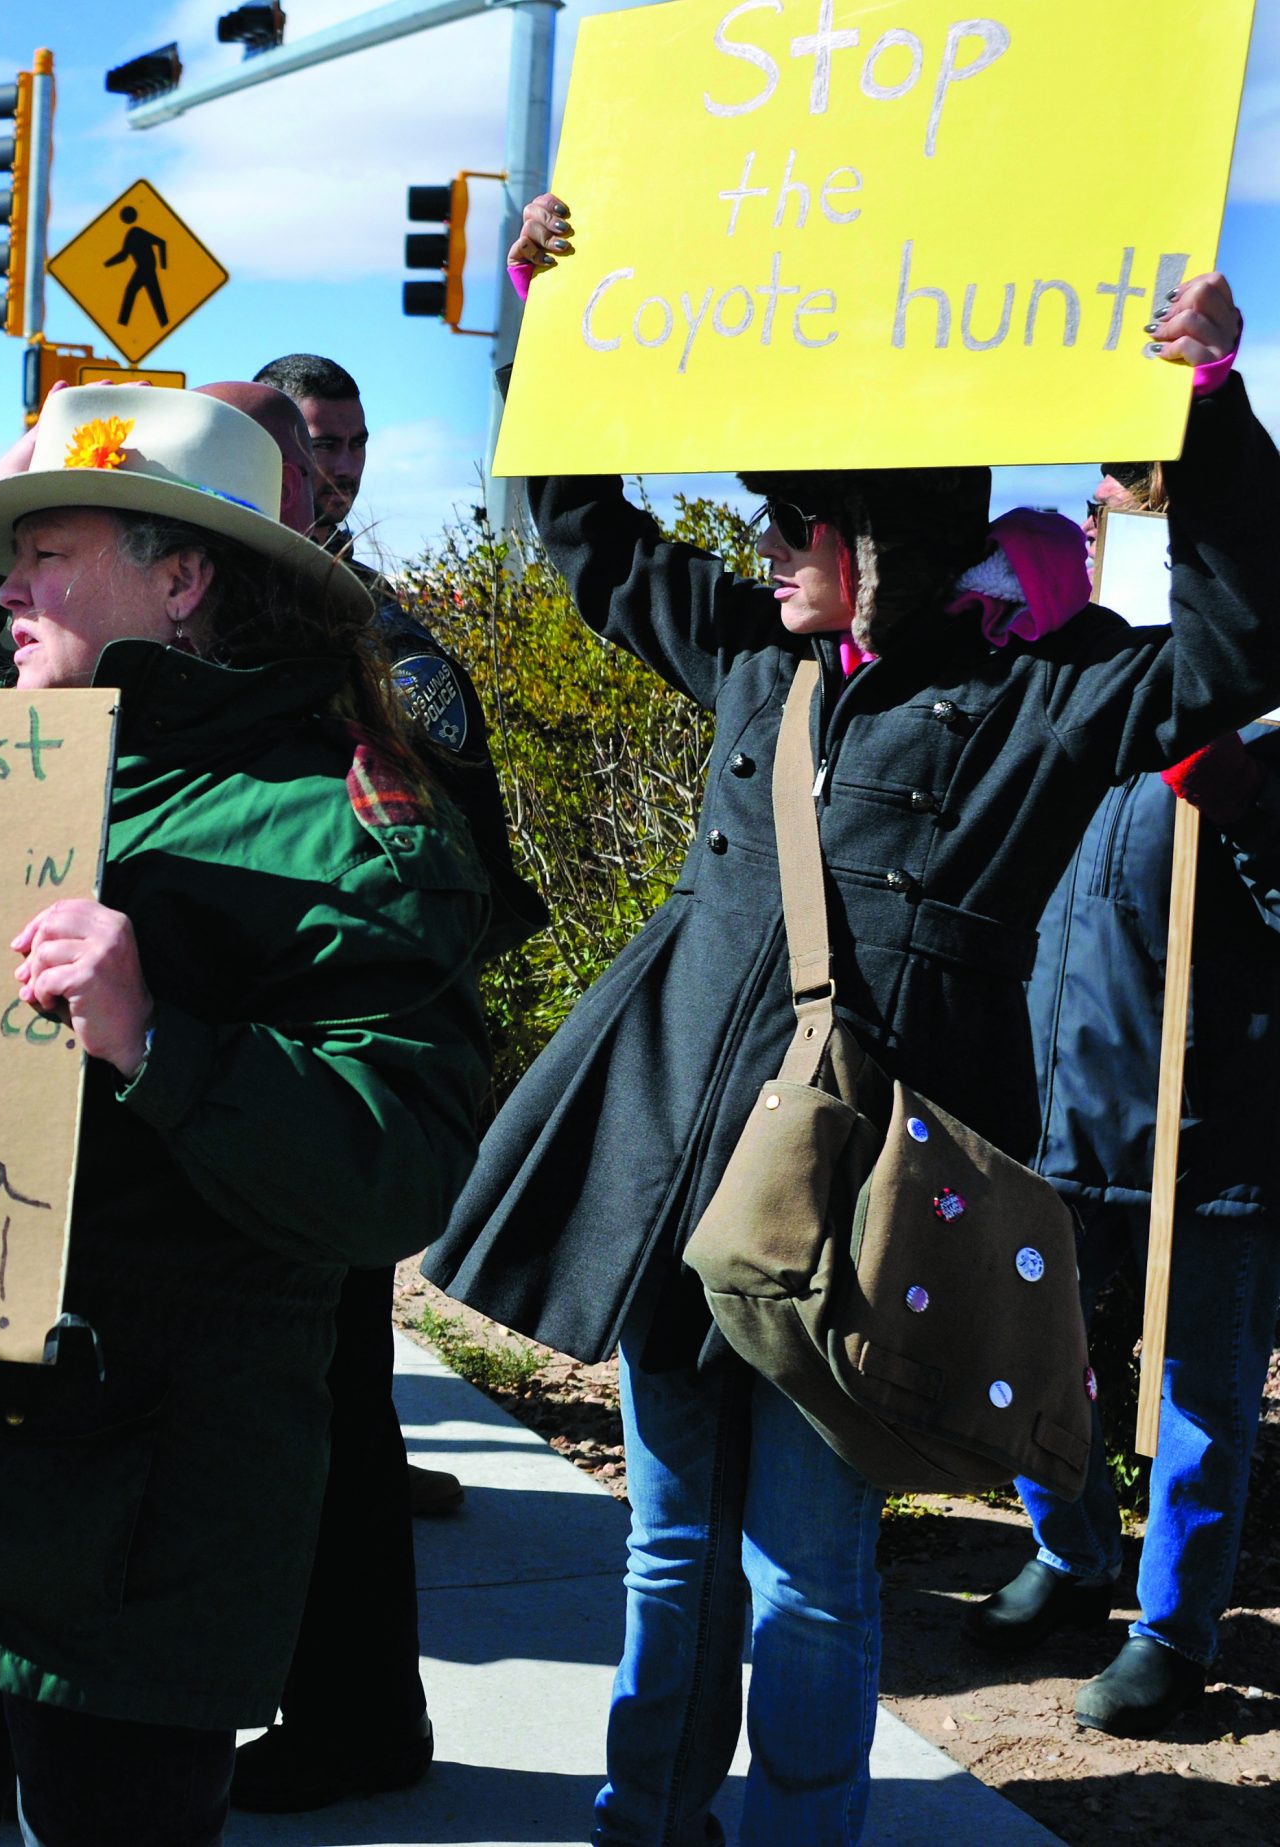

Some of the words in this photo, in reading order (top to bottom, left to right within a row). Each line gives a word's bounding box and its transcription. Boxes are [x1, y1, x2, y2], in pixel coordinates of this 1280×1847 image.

[704, 0, 1011, 157] Stop
[720, 148, 864, 236] the
[581, 251, 839, 375] Coyote
[891, 239, 1191, 360] hunt!
[423, 664, 452, 703] LUNAS
[423, 681, 457, 732] POLICE
